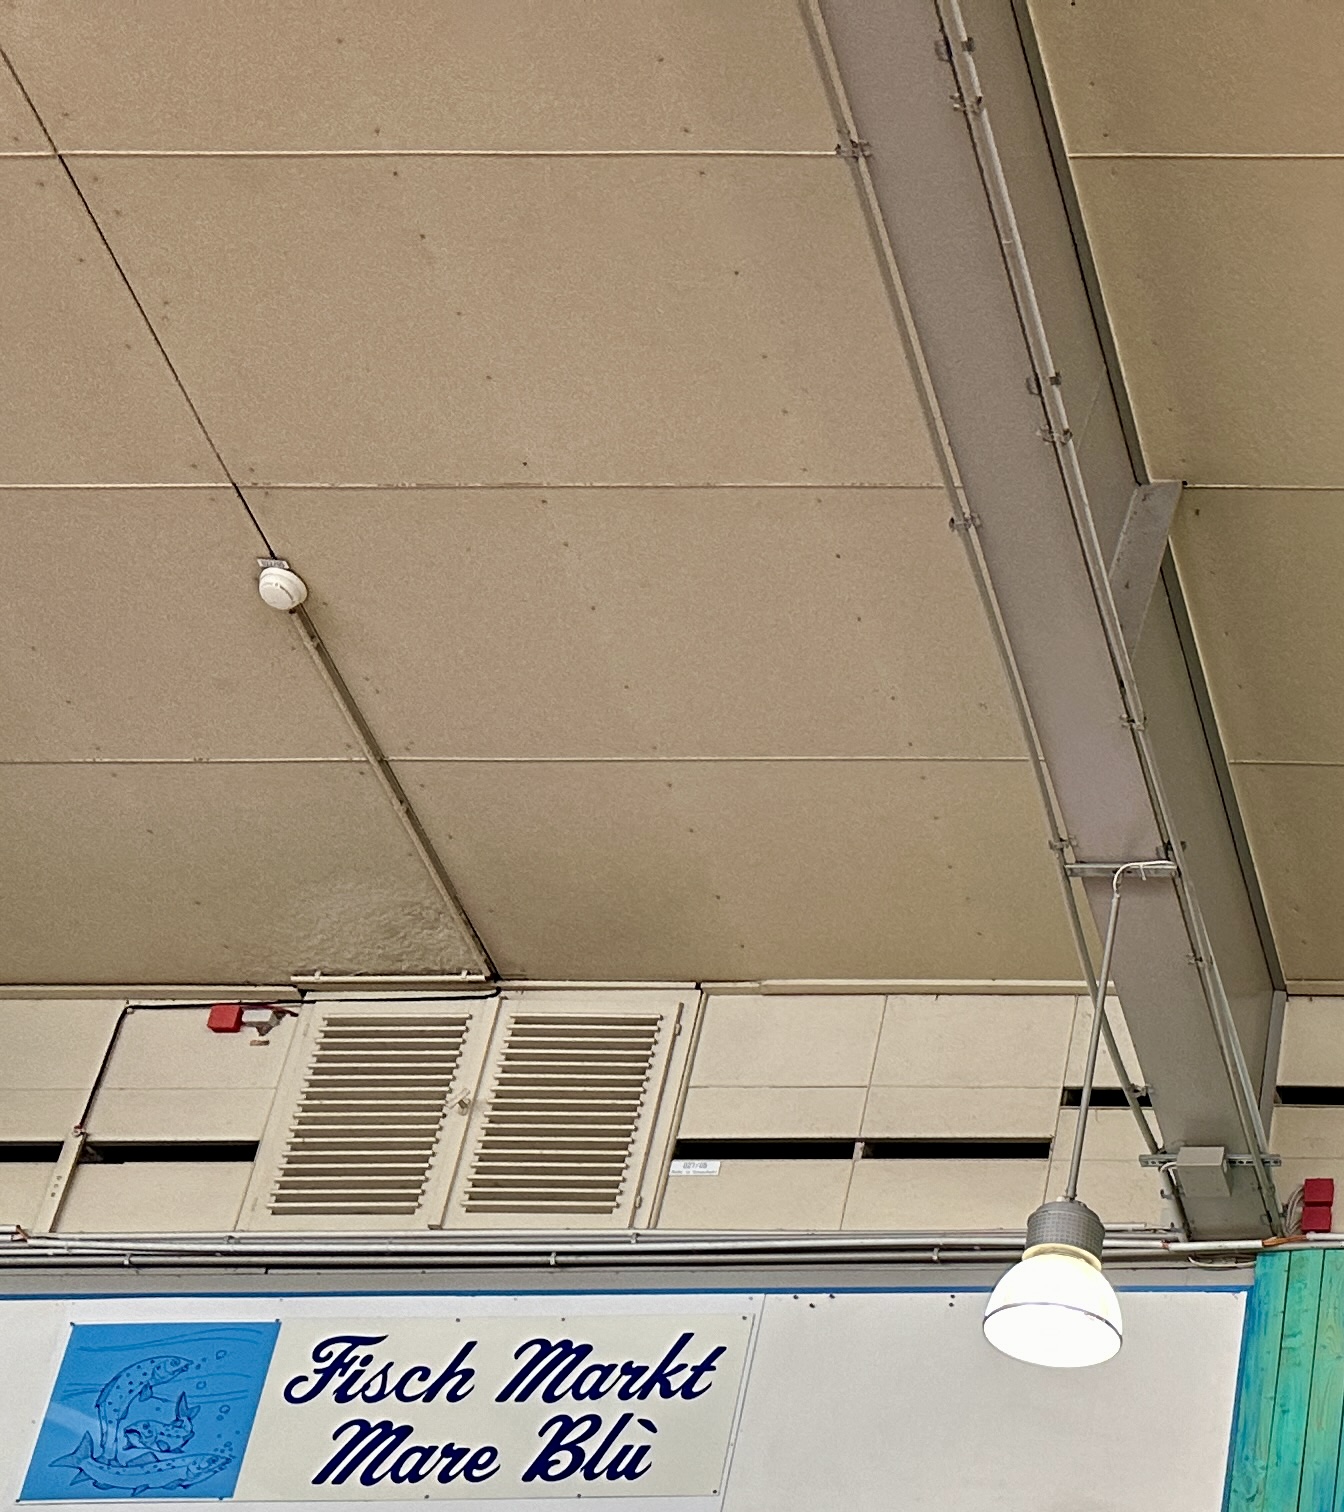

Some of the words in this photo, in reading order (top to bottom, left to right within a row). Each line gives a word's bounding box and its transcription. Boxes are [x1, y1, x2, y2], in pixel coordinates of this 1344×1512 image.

[284, 1334, 477, 1404] Fisch
[495, 1332, 727, 1402] Markt
[311, 1418, 501, 1486] Mare
[521, 1412, 658, 1482] Blù
